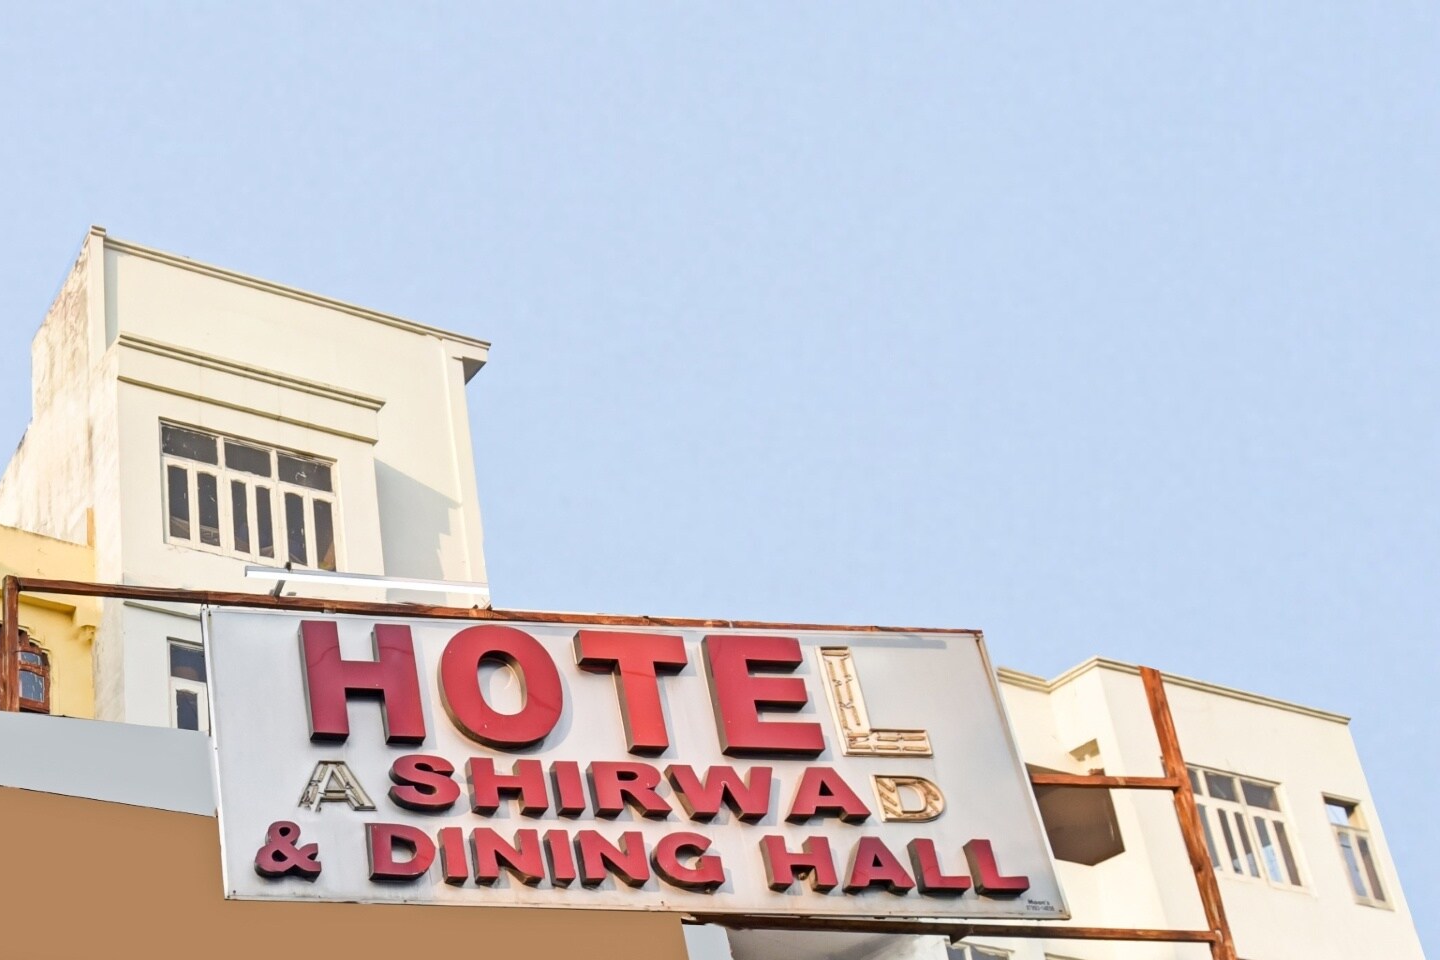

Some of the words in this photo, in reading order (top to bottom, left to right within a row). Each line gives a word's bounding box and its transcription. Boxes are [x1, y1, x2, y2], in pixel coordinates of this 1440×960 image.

[298, 619, 935, 757] HOTEL
[298, 754, 946, 825] ASHIRWAD
[255, 821, 322, 882] &
[365, 822, 727, 892] DINING
[759, 835, 1032, 898] HALL
